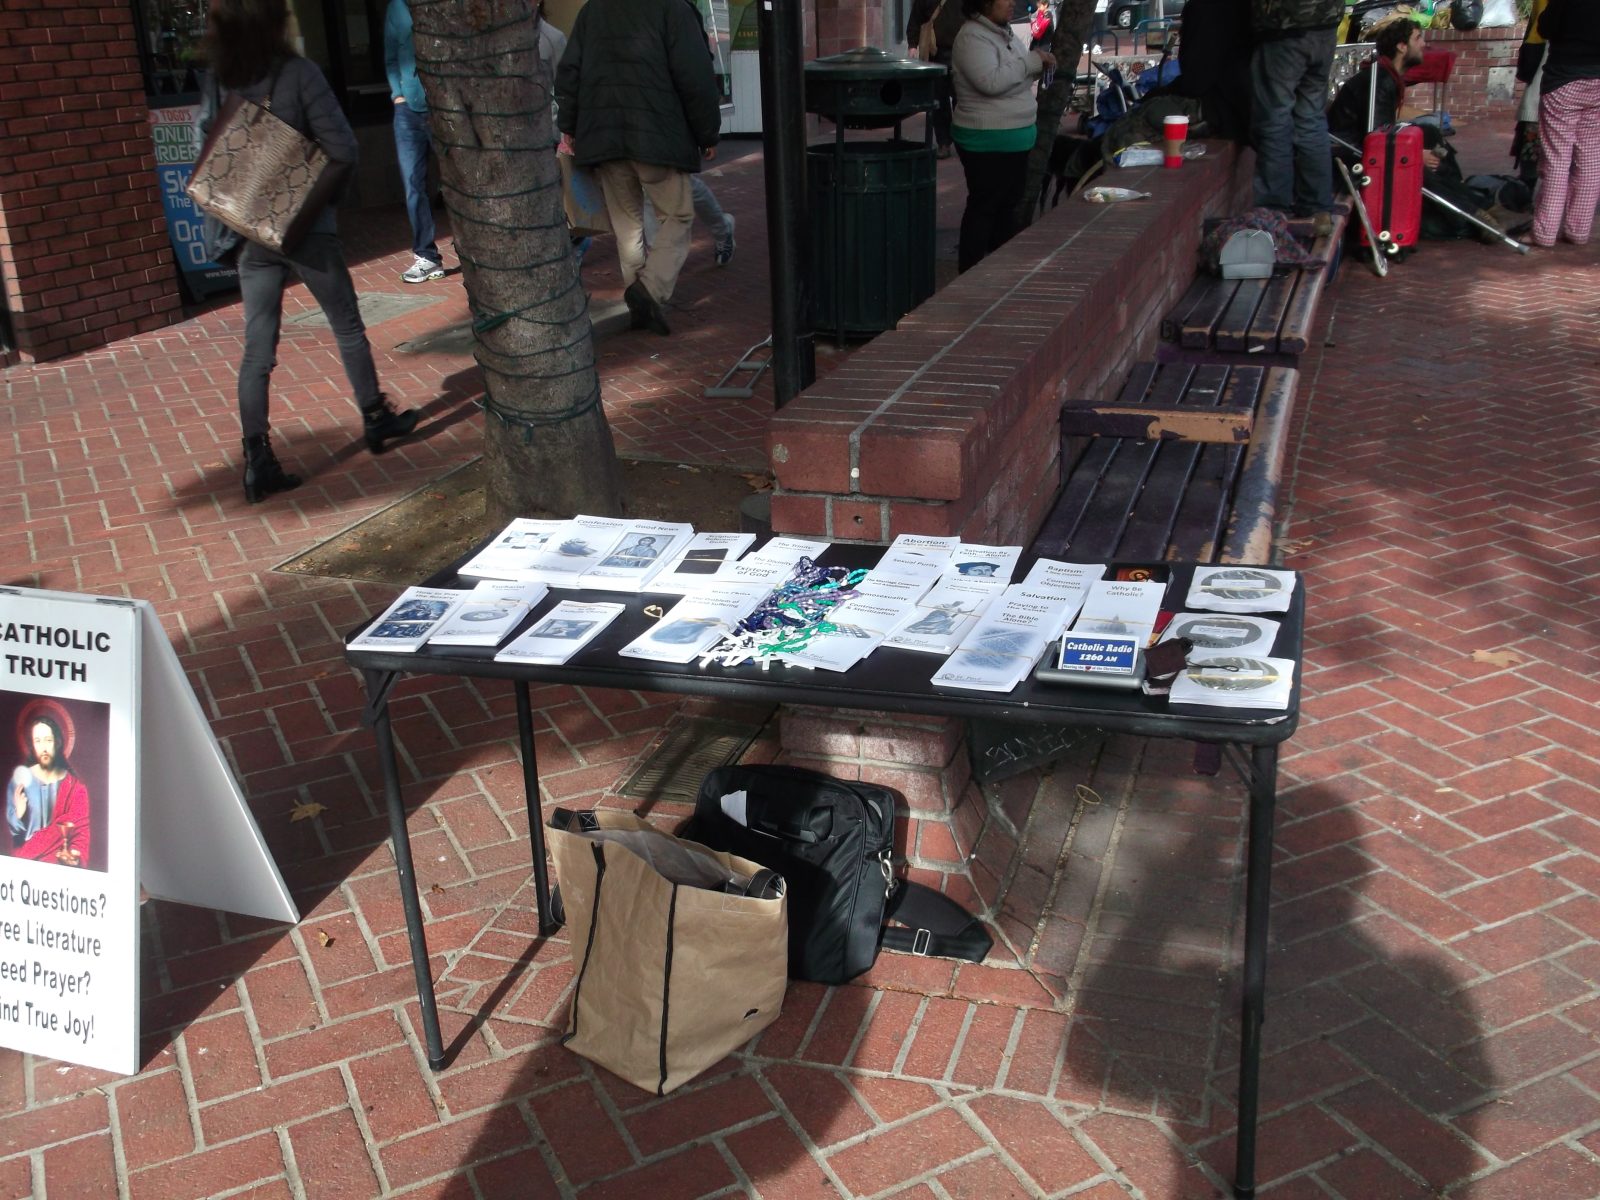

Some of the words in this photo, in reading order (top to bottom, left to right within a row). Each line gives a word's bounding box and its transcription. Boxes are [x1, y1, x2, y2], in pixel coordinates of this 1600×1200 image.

[160, 109, 192, 122] TOGO'S
[153, 124, 196, 144] ONLIN
[155, 144, 198, 162] RDER
[169, 195, 191, 209] The
[767, 558, 793, 566] Divinity
[735, 565, 778, 574] Existence
[1040, 581, 1081, 589] Objections
[1020, 591, 1066, 601] Salvation
[849, 602, 900, 612] Contraception
[854, 607, 896, 616] Sterilization
[1008, 601, 1038, 609] Praying
[0, 622, 111, 653] ATHOLIC
[1067, 642, 1104, 652] Catholic
[1105, 644, 1133, 653] Radio
[1078, 653, 1104, 662] 1260
[5, 654, 87, 682] TRUTH
[20, 879, 107, 918] Questions?
[27, 919, 102, 957] Literature
[33, 960, 91, 997] Prayer?
[25, 1001, 58, 1031] True
[64, 1009, 94, 1044] Joy!
